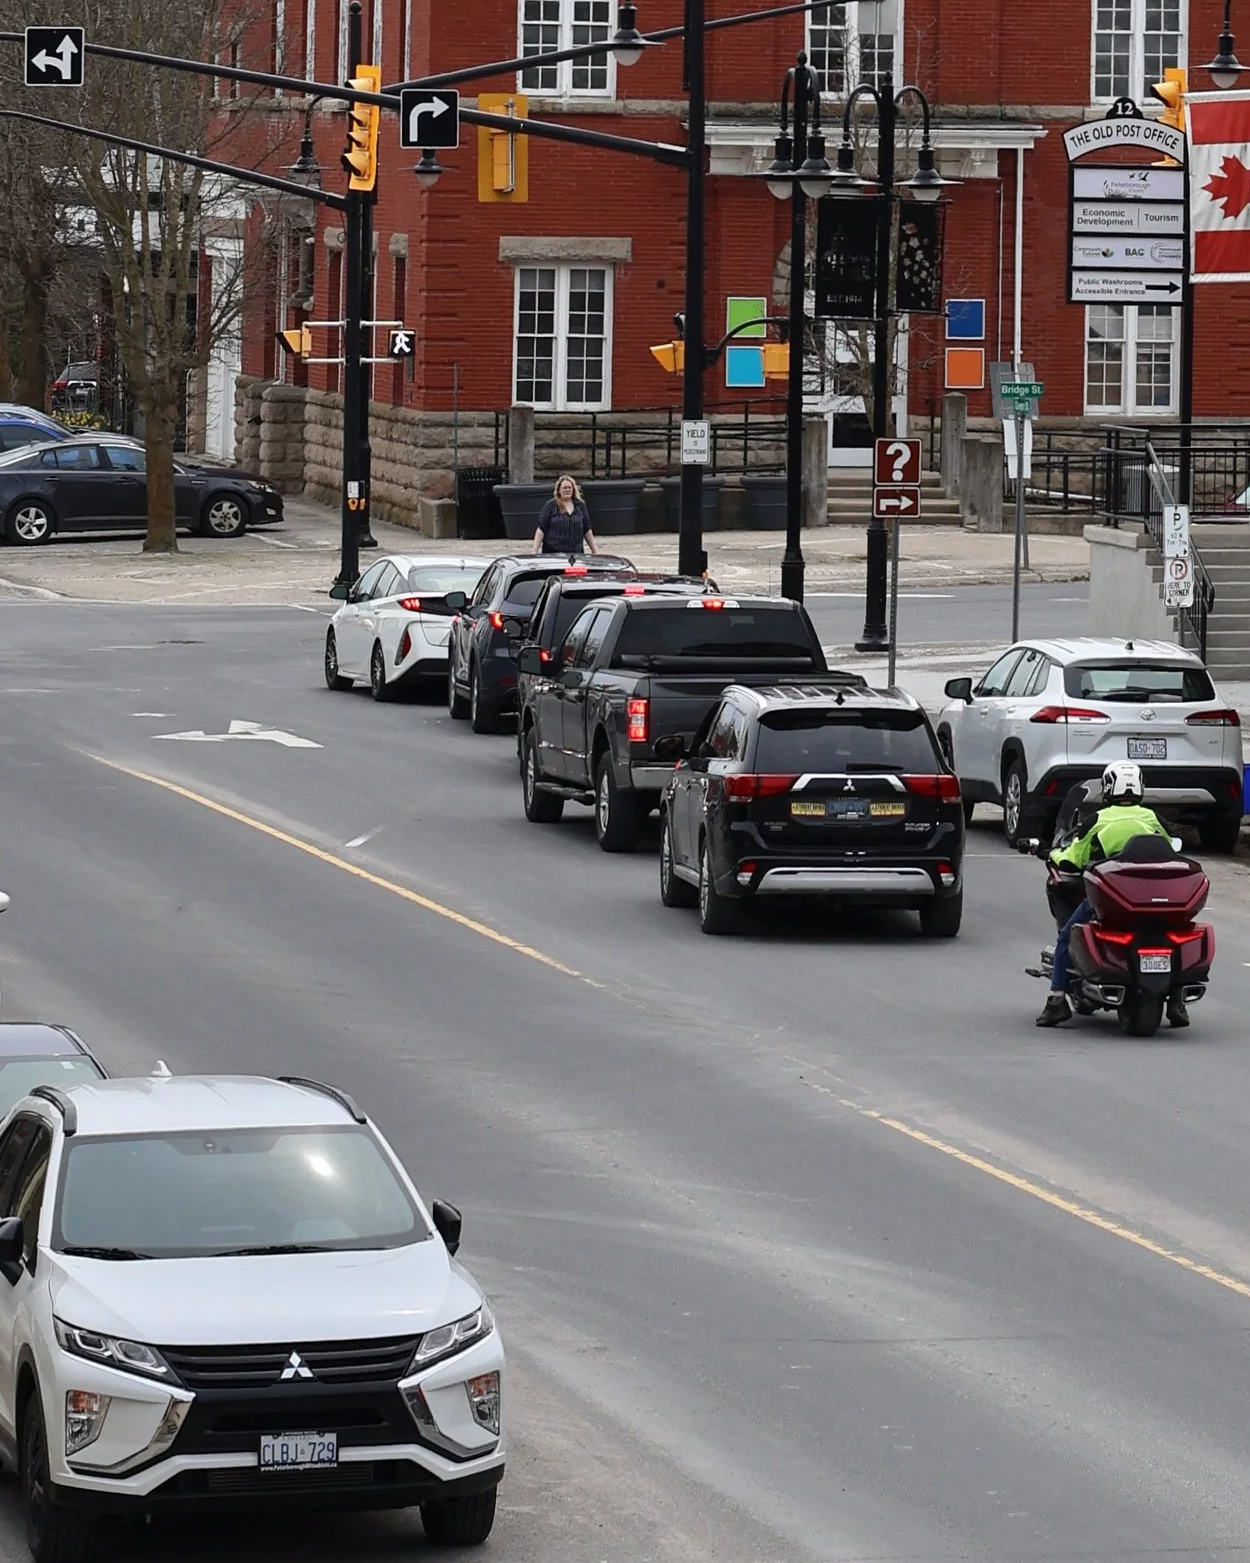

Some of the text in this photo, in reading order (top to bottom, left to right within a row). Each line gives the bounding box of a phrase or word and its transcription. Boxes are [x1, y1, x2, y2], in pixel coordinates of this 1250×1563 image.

[1116, 102, 1134, 115] 12
[1070, 124, 1179, 150] THE OLD POST OFFICE
[1082, 209, 1125, 217] Economic
[1144, 213, 1179, 222] Tourism
[1077, 217, 1133, 227] Development
[1001, 384, 1029, 395] Bridge
[686, 429, 706, 438] YIELD
[1168, 581, 1191, 589] HERE TO
[1152, 743, 1165, 754] 702
[263, 1441, 335, 1464] CLBJ 729
